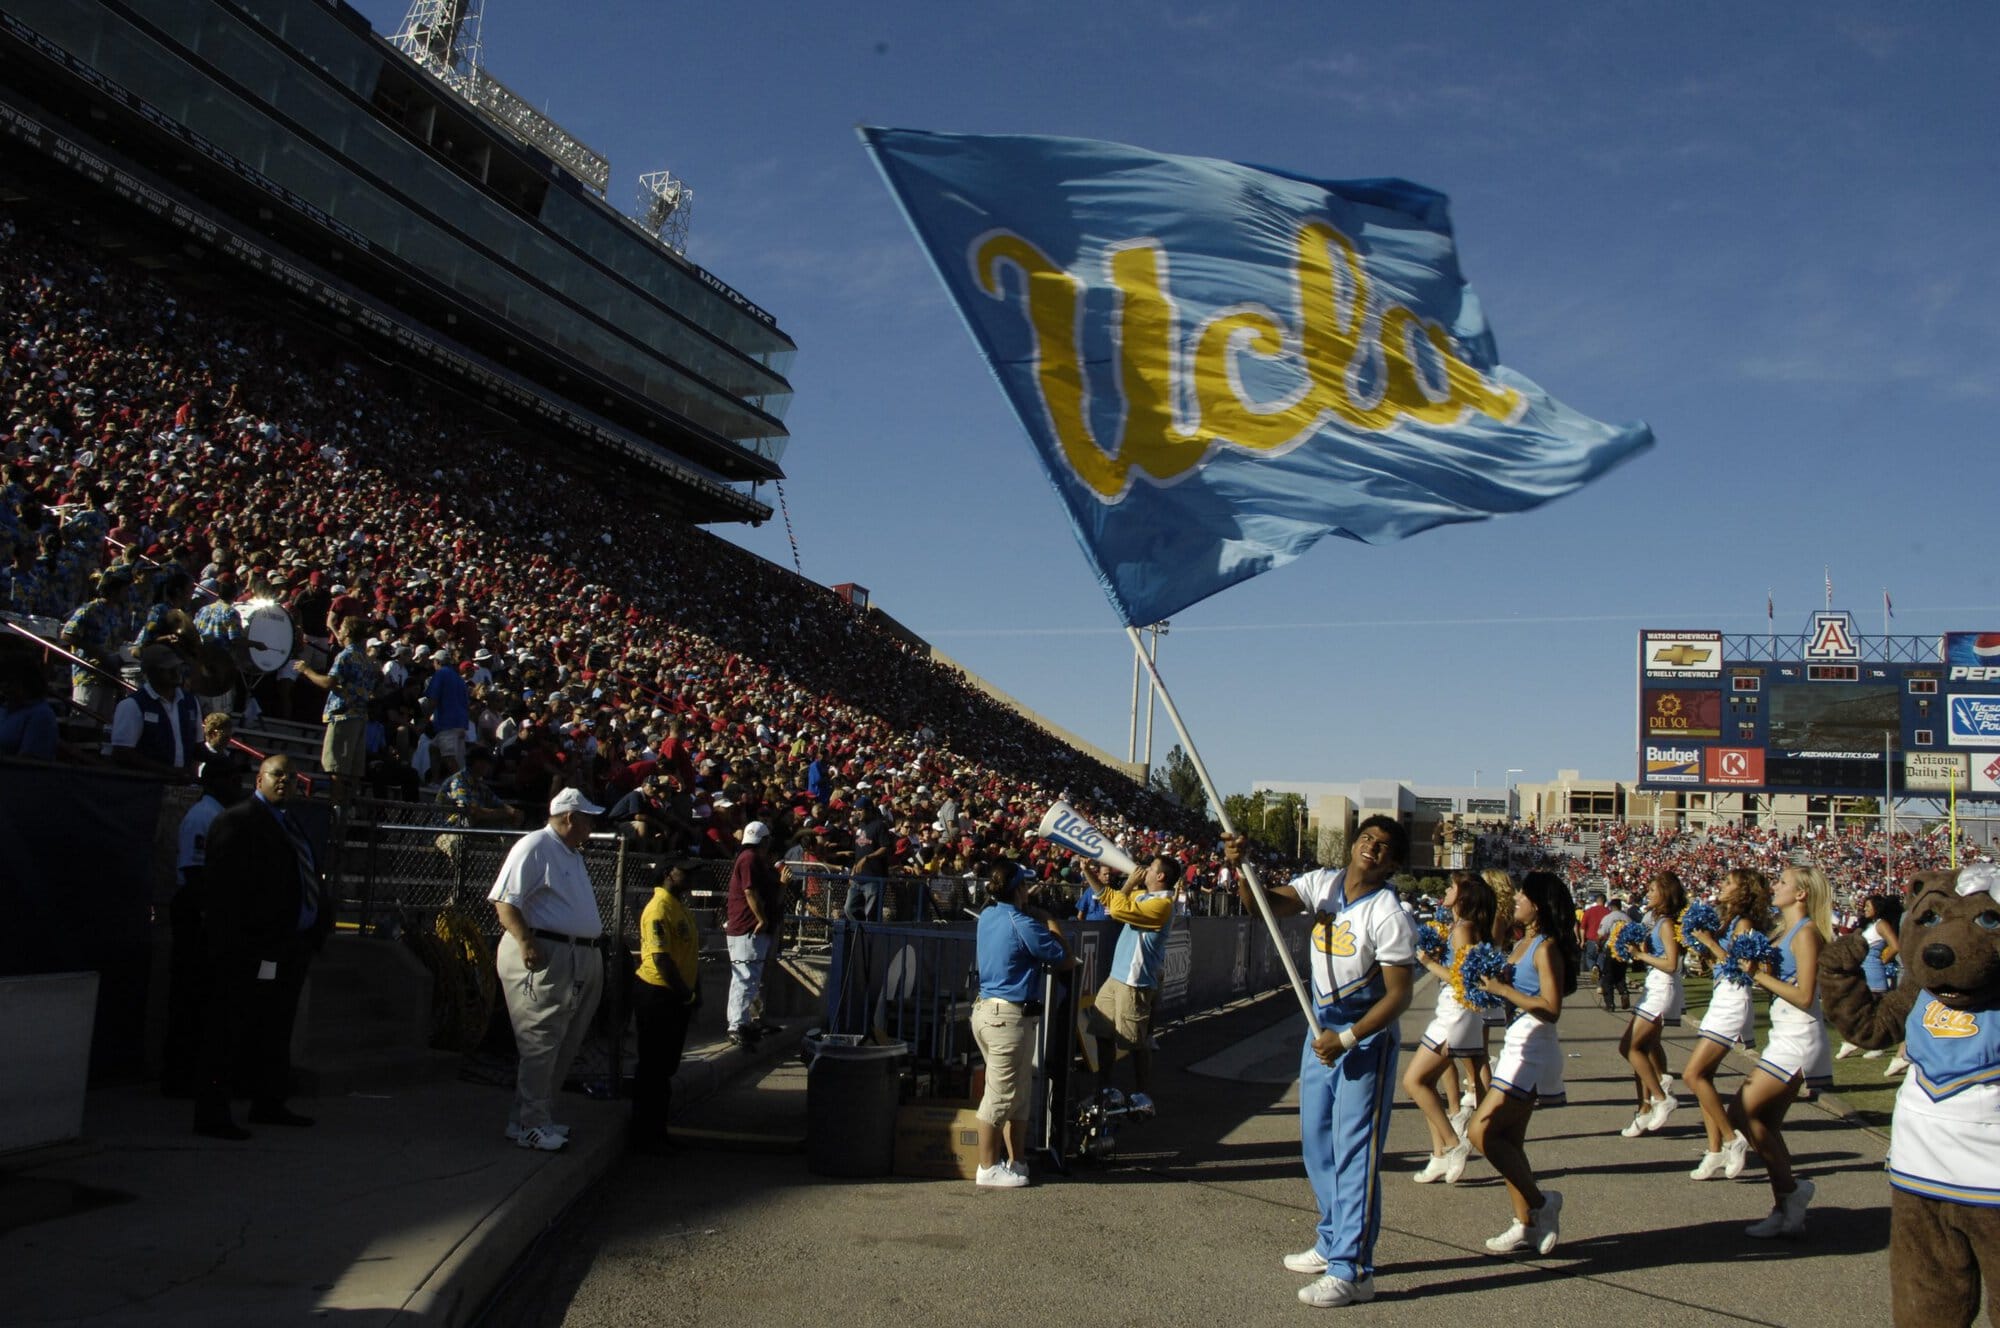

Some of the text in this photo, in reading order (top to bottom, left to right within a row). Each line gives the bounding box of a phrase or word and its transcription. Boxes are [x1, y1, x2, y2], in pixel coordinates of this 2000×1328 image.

[1649, 716, 1689, 728] DEL SOL
[1646, 746, 1699, 764] Budget
[1913, 754, 1958, 765] Arizona
[1905, 766, 1938, 779] Daily
